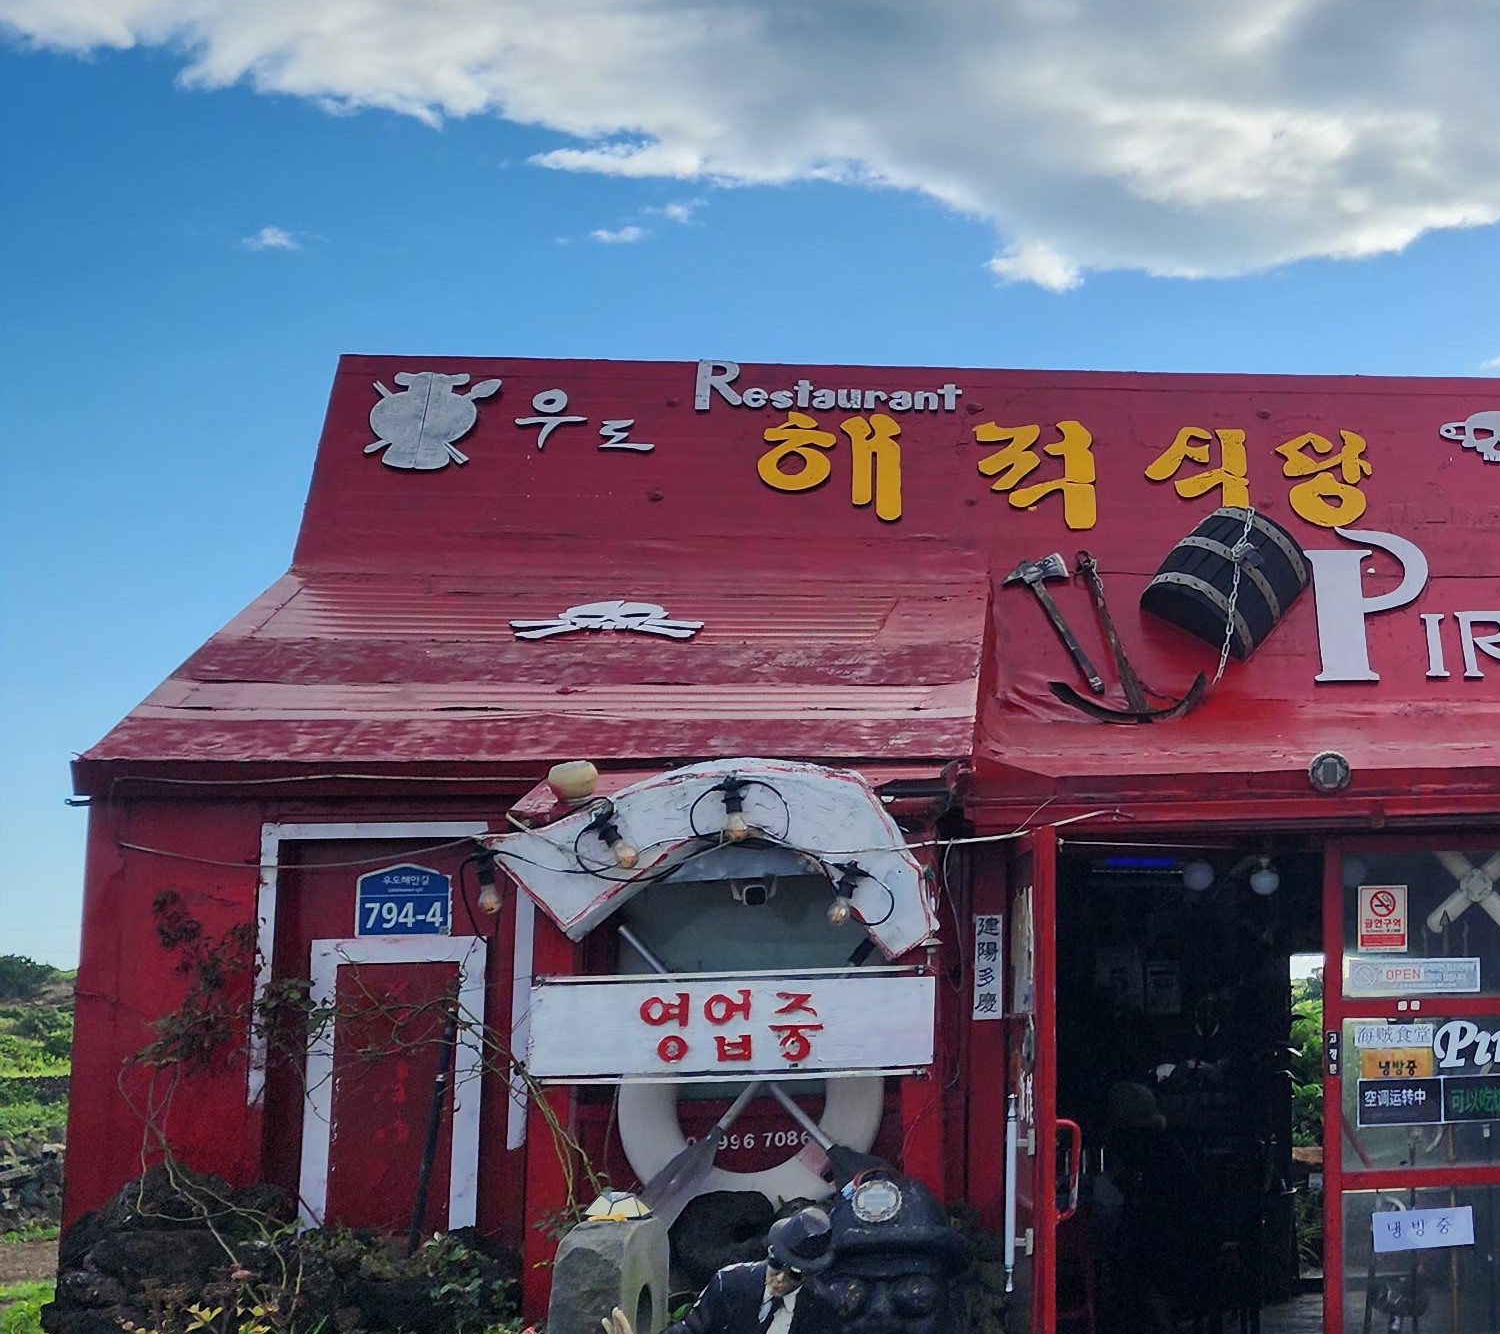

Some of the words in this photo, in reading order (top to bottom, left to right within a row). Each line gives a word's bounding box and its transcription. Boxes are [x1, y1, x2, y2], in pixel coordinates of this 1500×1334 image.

[695, 359, 963, 412] Restaurant
[514, 388, 656, 452] 우도
[382, 874, 430, 886] 우도해안길
[364, 901, 444, 929] 794-4
[1365, 918, 1402, 929] 금연구역
[974, 917, 999, 1014] 建陽多慶
[1385, 968, 1422, 981] OPEN
[639, 988, 825, 1063] 영업중
[1378, 1058, 1418, 1076] 냉방중
[1364, 1088, 1427, 1108] 空调运转中
